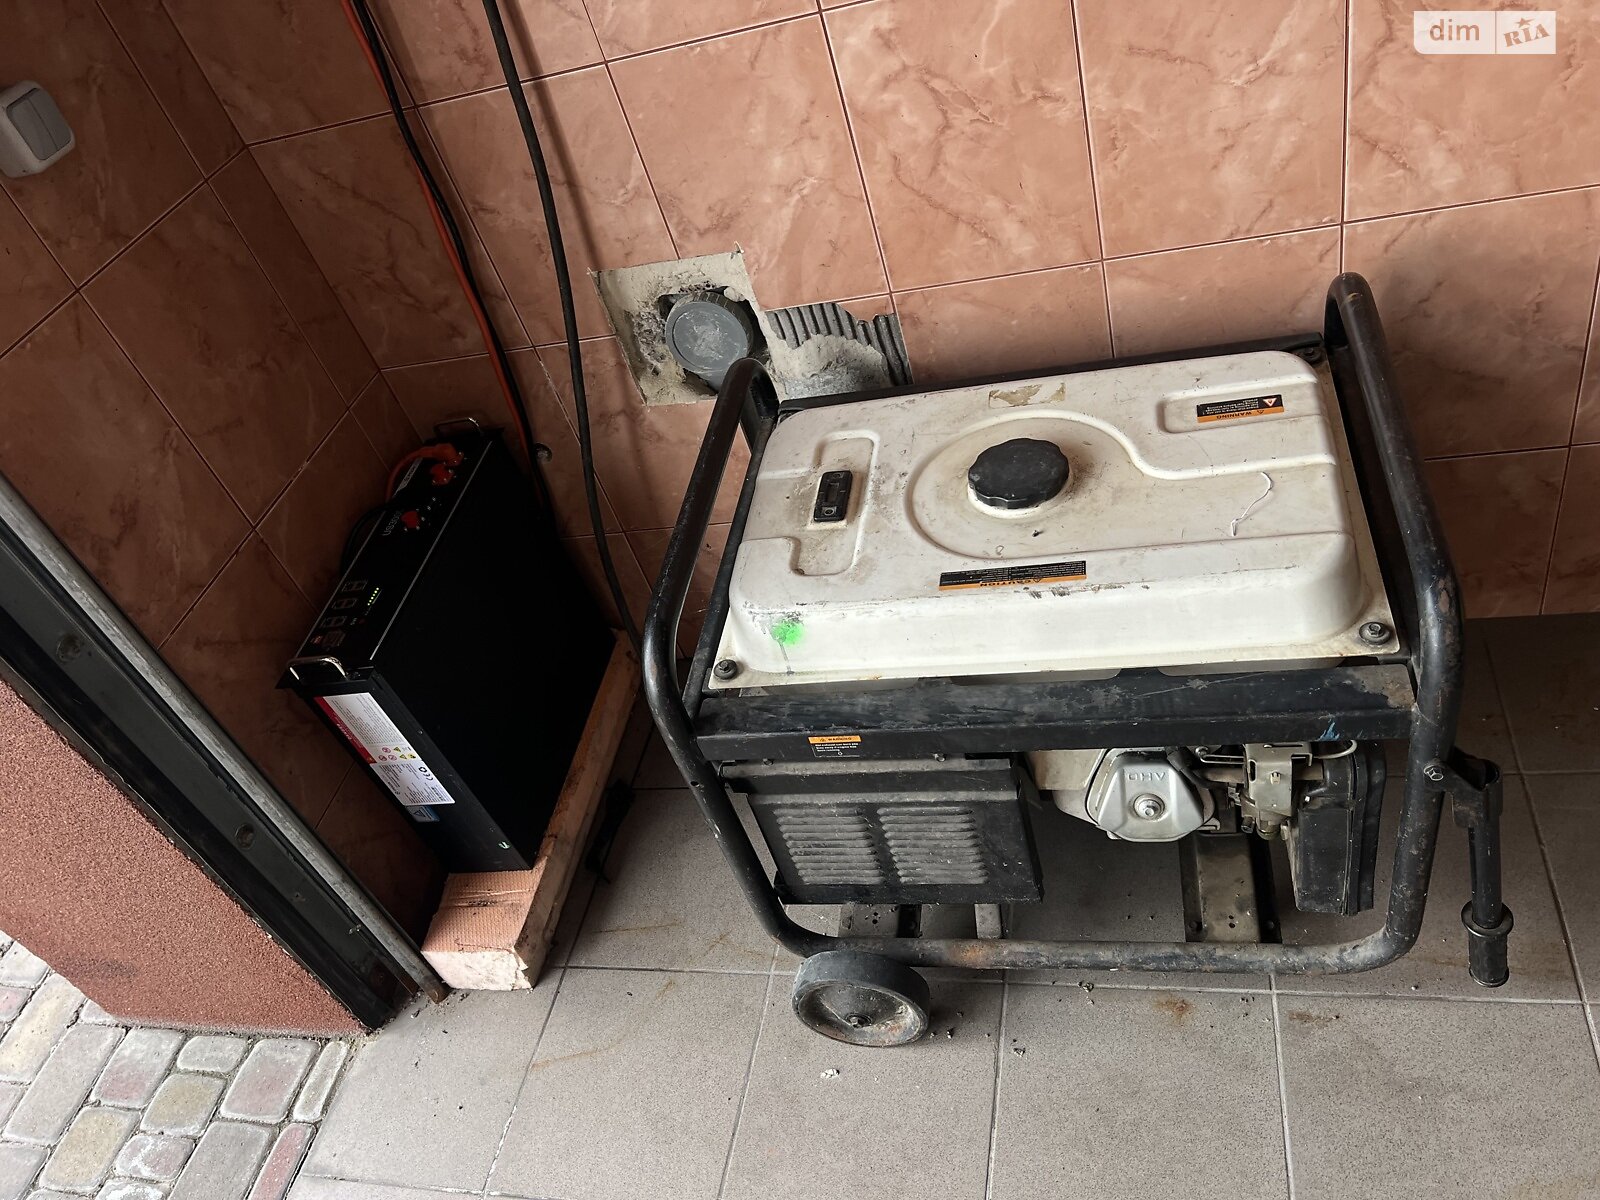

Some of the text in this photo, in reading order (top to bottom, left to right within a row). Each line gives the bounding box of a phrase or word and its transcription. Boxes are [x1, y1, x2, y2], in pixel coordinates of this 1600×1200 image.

[1216, 410, 1252, 420] WARNING
[980, 578, 1032, 587] CAUTION
[1128, 772, 1166, 781] OHV
